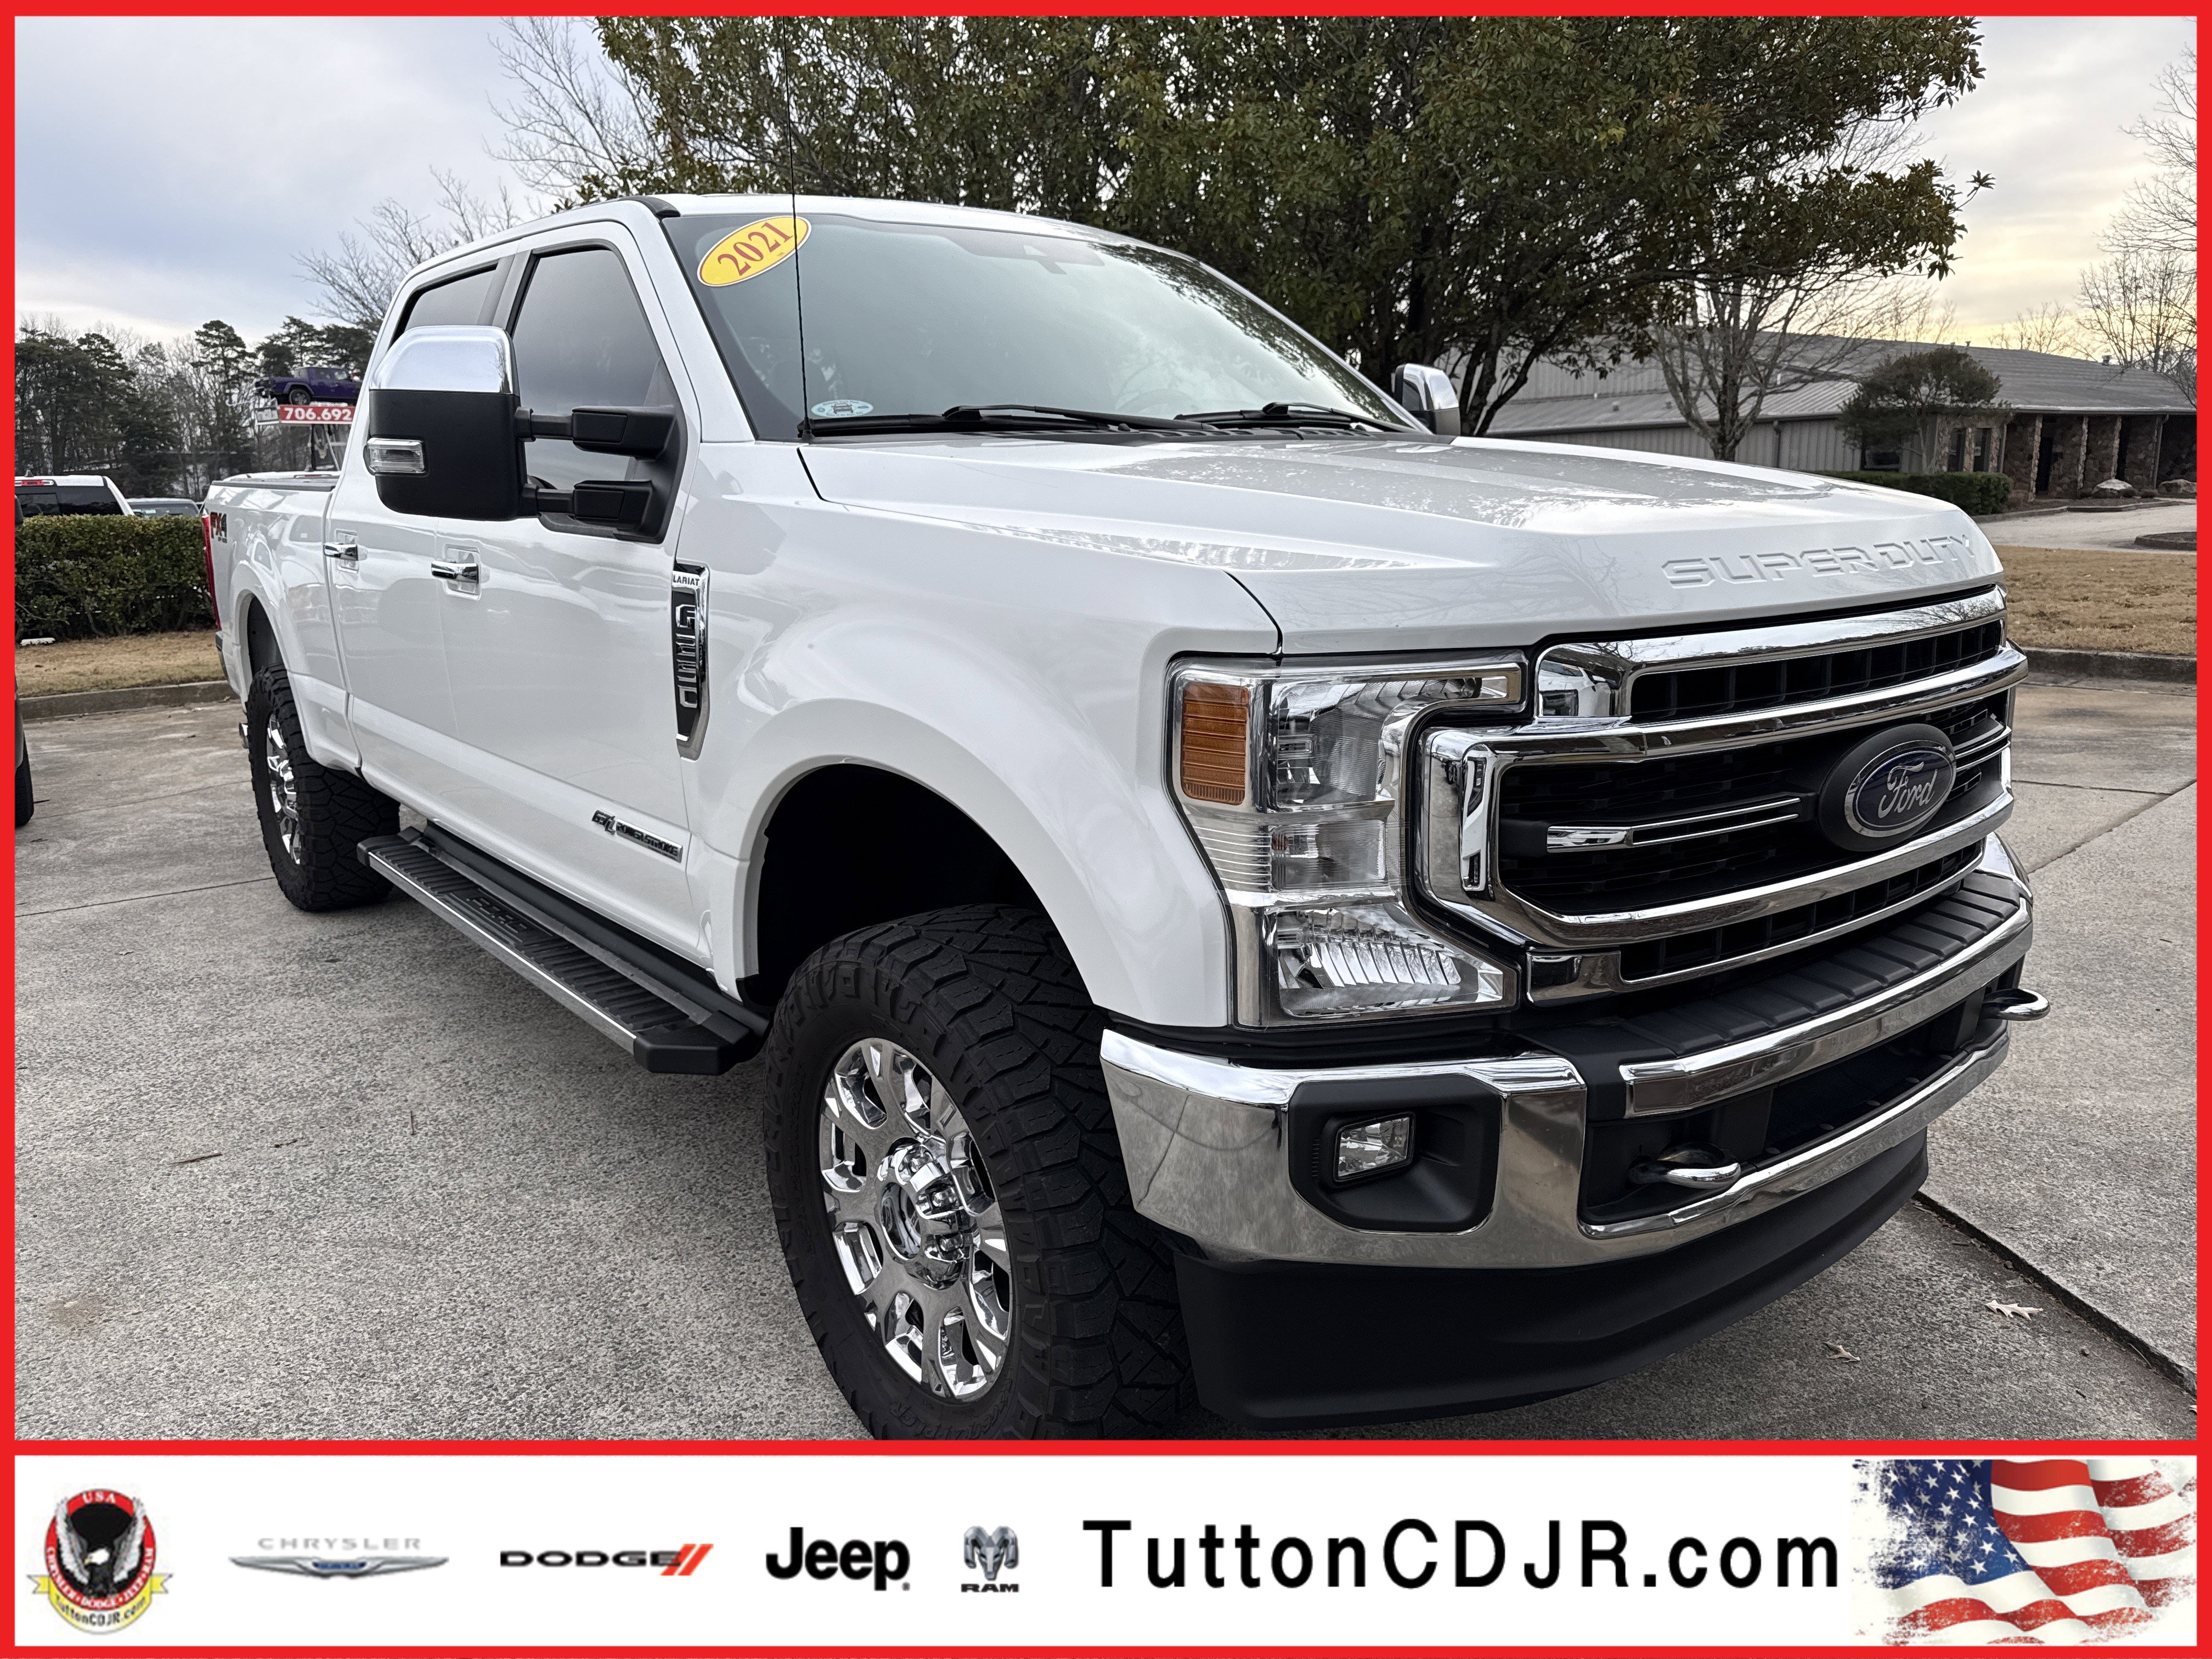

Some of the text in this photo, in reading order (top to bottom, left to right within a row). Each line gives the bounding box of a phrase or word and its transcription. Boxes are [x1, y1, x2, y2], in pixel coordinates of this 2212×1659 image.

[717, 222, 794, 276] 2021
[284, 407, 353, 421] 706.692
[673, 575, 700, 586] LARIAT
[1661, 534, 1976, 589] SUPER DUTY
[1878, 761, 1938, 819] Ford
